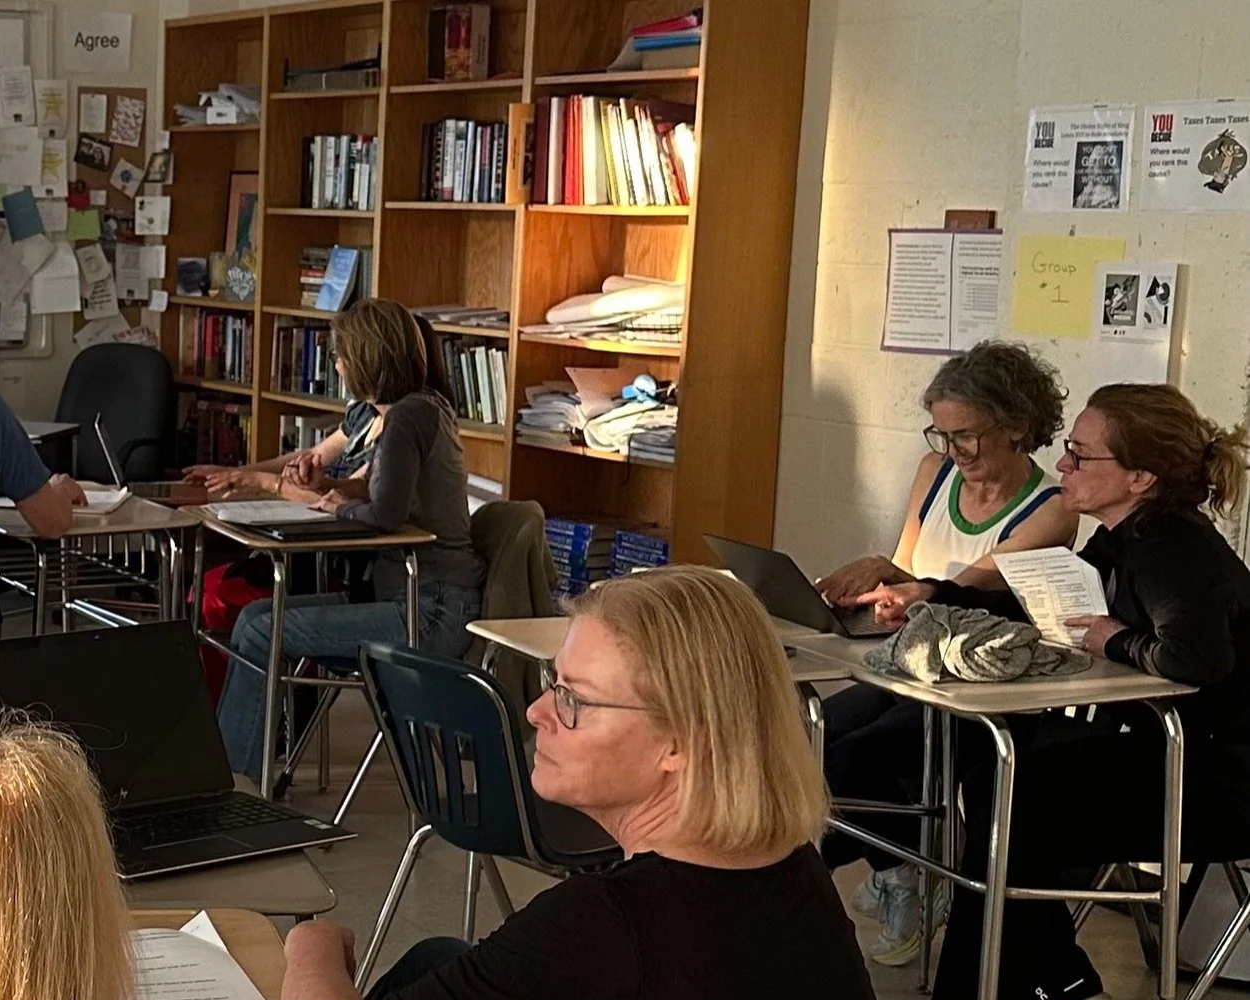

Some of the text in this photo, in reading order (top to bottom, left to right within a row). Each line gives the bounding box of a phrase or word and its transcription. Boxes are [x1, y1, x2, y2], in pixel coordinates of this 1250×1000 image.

[74, 32, 120, 52] Agree
[1152, 114, 1173, 132] YOU
[1183, 115, 1249, 125] Taxes Taxes Taxes
[1035, 121, 1055, 139] YOU
[1172, 147, 1190, 155] would
[1032, 251, 1077, 275] Group
